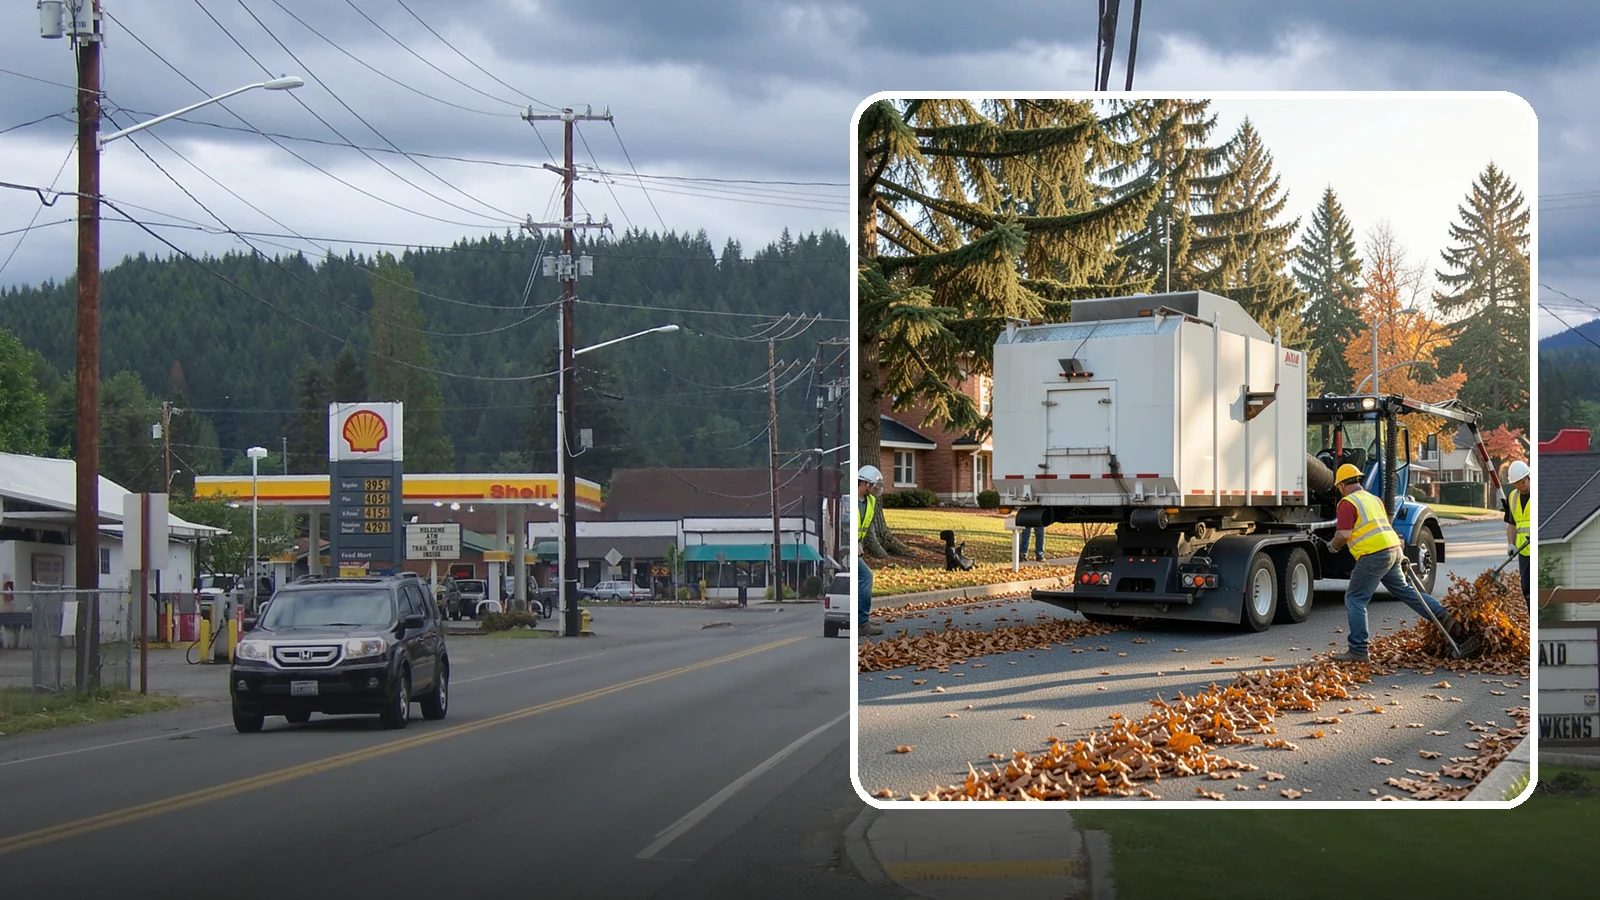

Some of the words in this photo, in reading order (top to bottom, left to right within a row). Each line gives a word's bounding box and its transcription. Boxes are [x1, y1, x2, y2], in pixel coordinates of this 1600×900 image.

[366, 480, 383, 490] 395
[490, 484, 547, 499] Shell
[366, 494, 383, 504] 405
[366, 508, 383, 518] 415
[366, 522, 383, 532] 429
